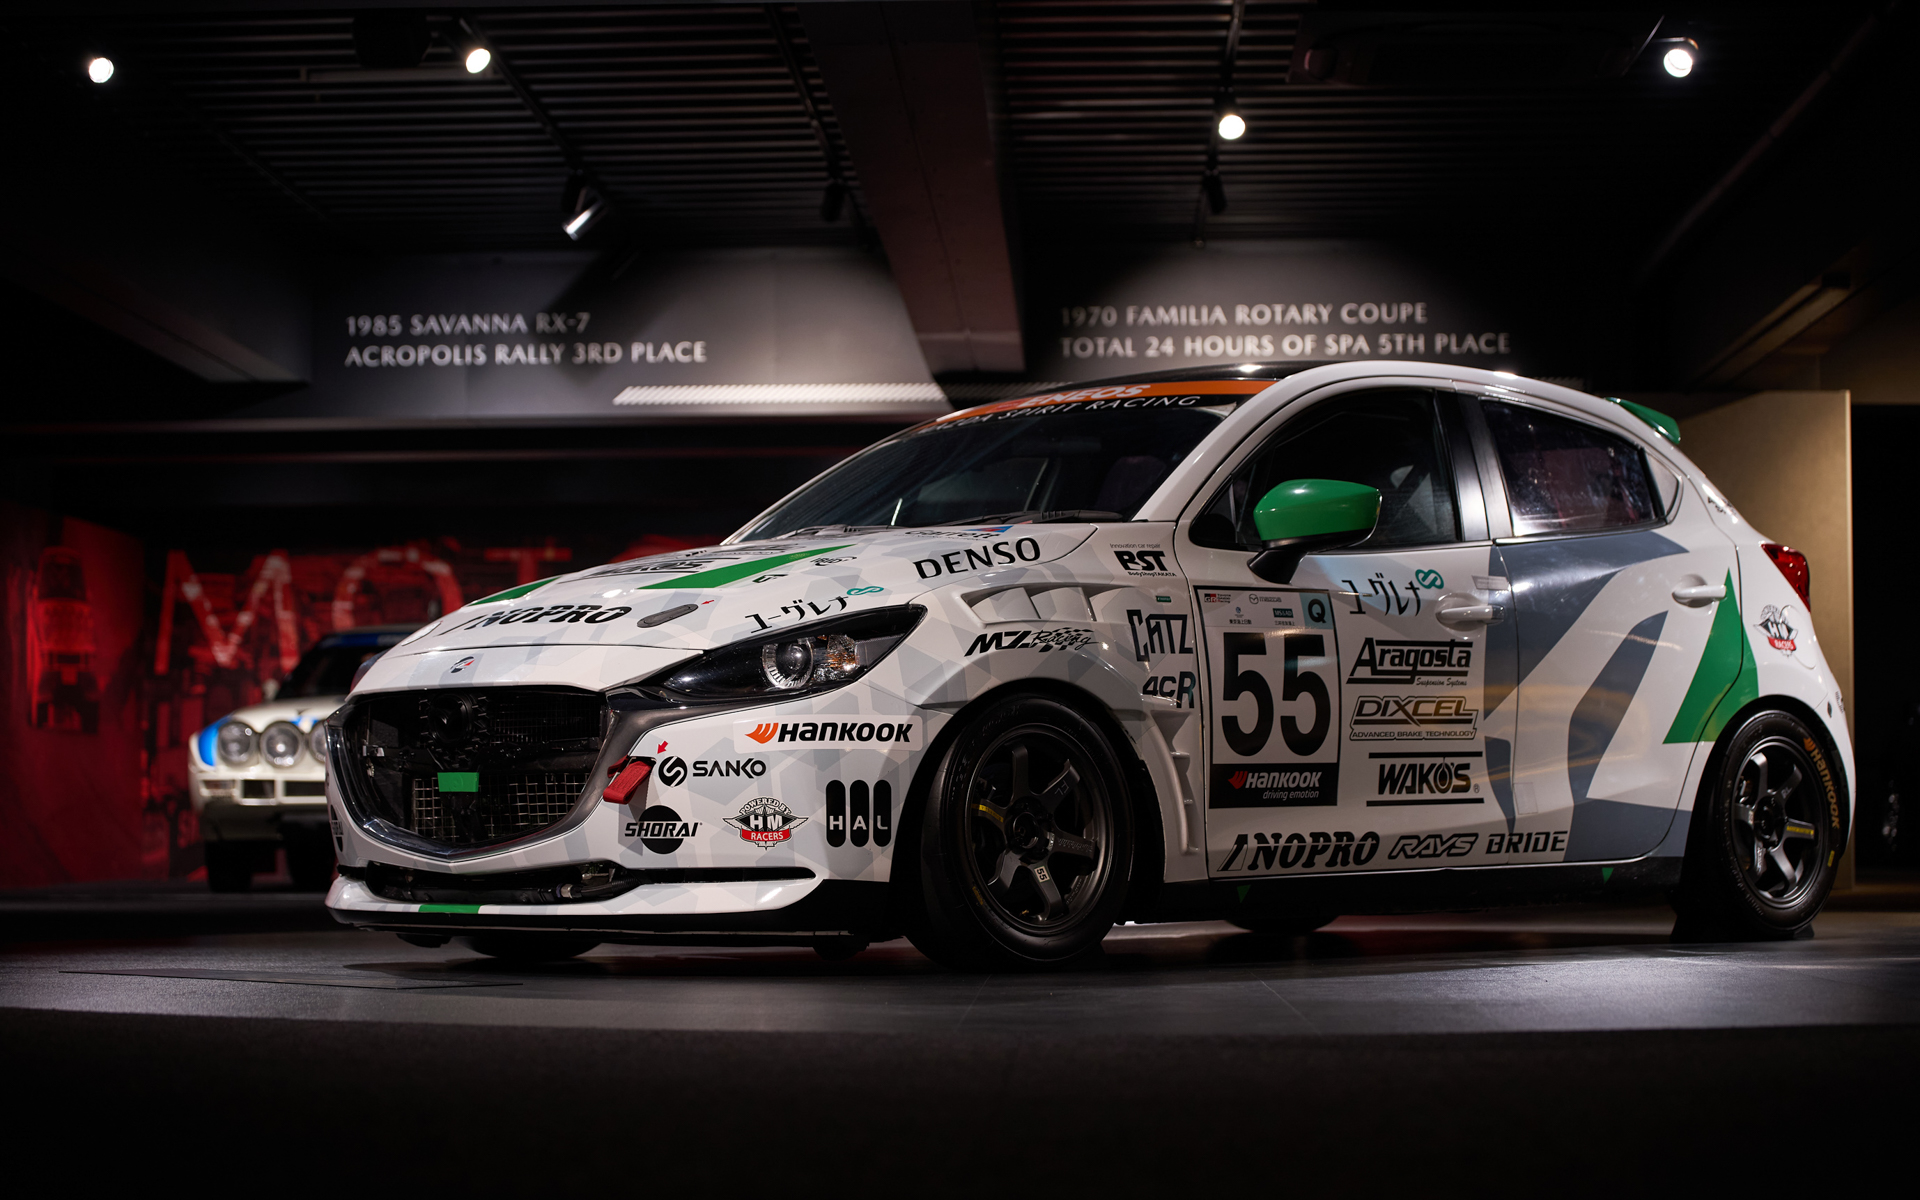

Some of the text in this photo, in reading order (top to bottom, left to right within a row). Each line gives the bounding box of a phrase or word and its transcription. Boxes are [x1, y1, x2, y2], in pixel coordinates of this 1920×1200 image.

[346, 312, 591, 335] 1985 SAVANNA RX-7
[1061, 302, 1427, 327] 1970 FAMILIA ROTARY COUPE
[344, 341, 708, 367] ACROPOLIS RALLY 3RD PLACE
[1061, 332, 1511, 358] TOTAL 24 HOURS OF SPA 5TH PLACE
[998, 402, 1082, 420] SPIRIT
[1085, 396, 1201, 412] RACING
[1017, 384, 1150, 407] ENEOS
[913, 537, 1041, 579] DENSO
[1341, 572, 1422, 616] ユーグレナ
[464, 604, 632, 631] NOPRO
[745, 595, 849, 634] ユーグレナ
[1307, 598, 1327, 624] Q
[963, 630, 1037, 657] MZ
[1126, 609, 1194, 662] CATZ
[1346, 637, 1474, 684] Aragosta
[1221, 632, 1332, 757] 55
[1416, 677, 1468, 687] Suspension Systems
[1355, 699, 1474, 727] DIXCEL
[692, 757, 766, 779] SANKO
[739, 797, 792, 815] POWERED BY
[1262, 789, 1320, 801] driving emotion
[625, 822, 700, 838] SHORAI
[749, 814, 783, 831] HM
[750, 831, 784, 841] RACERS
[1388, 833, 1479, 859] RAYS
[1486, 830, 1568, 855] BRIDE
[1247, 830, 1380, 870] NOPRO
[1036, 867, 1048, 882] 55
